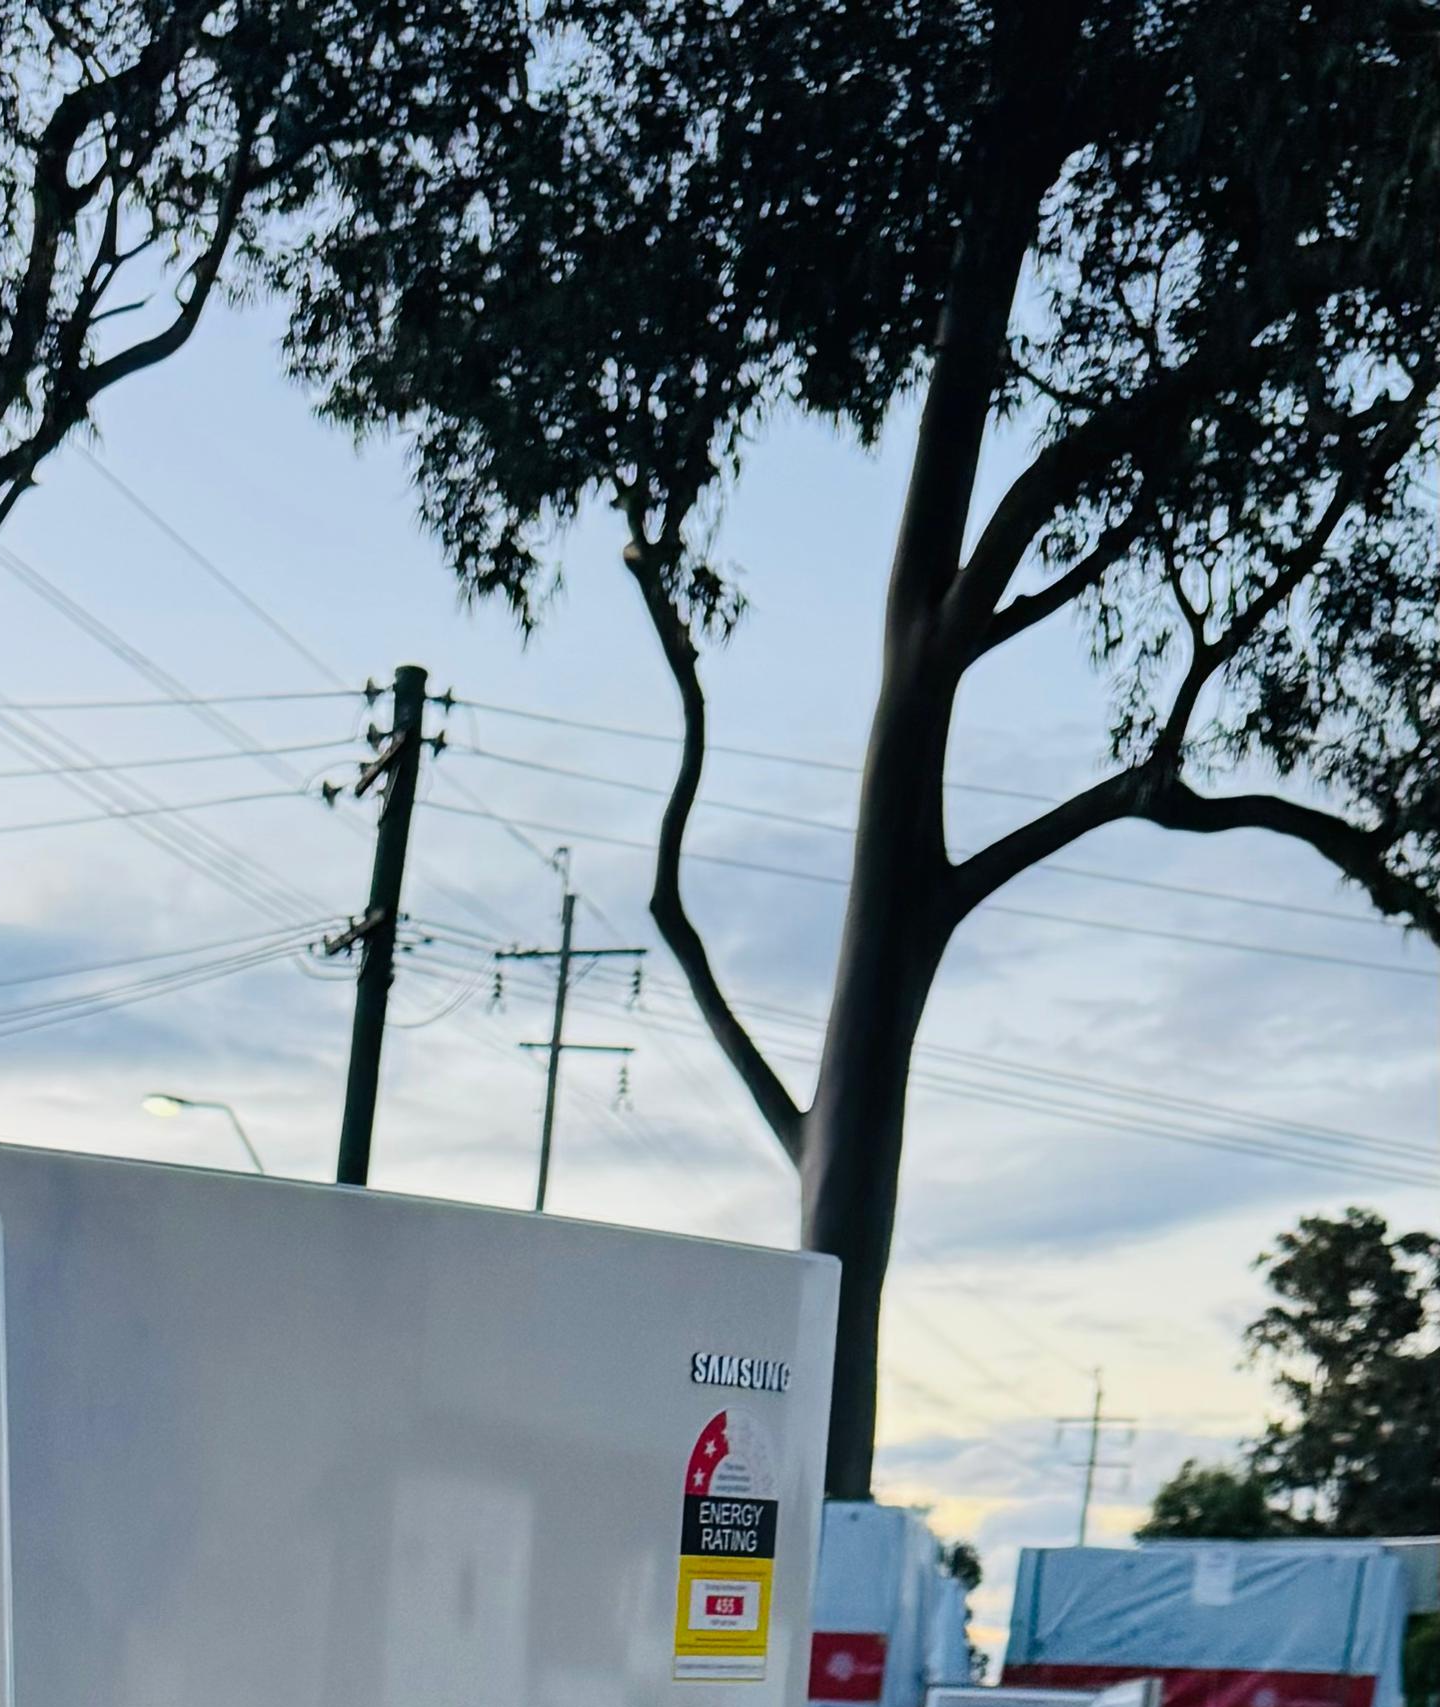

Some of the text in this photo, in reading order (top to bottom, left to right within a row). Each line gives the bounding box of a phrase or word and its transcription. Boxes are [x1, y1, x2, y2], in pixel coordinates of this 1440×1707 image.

[692, 1352, 791, 1391] SAMSUNG
[699, 1501, 764, 1526] ENERGY
[701, 1528, 758, 1553] RATING
